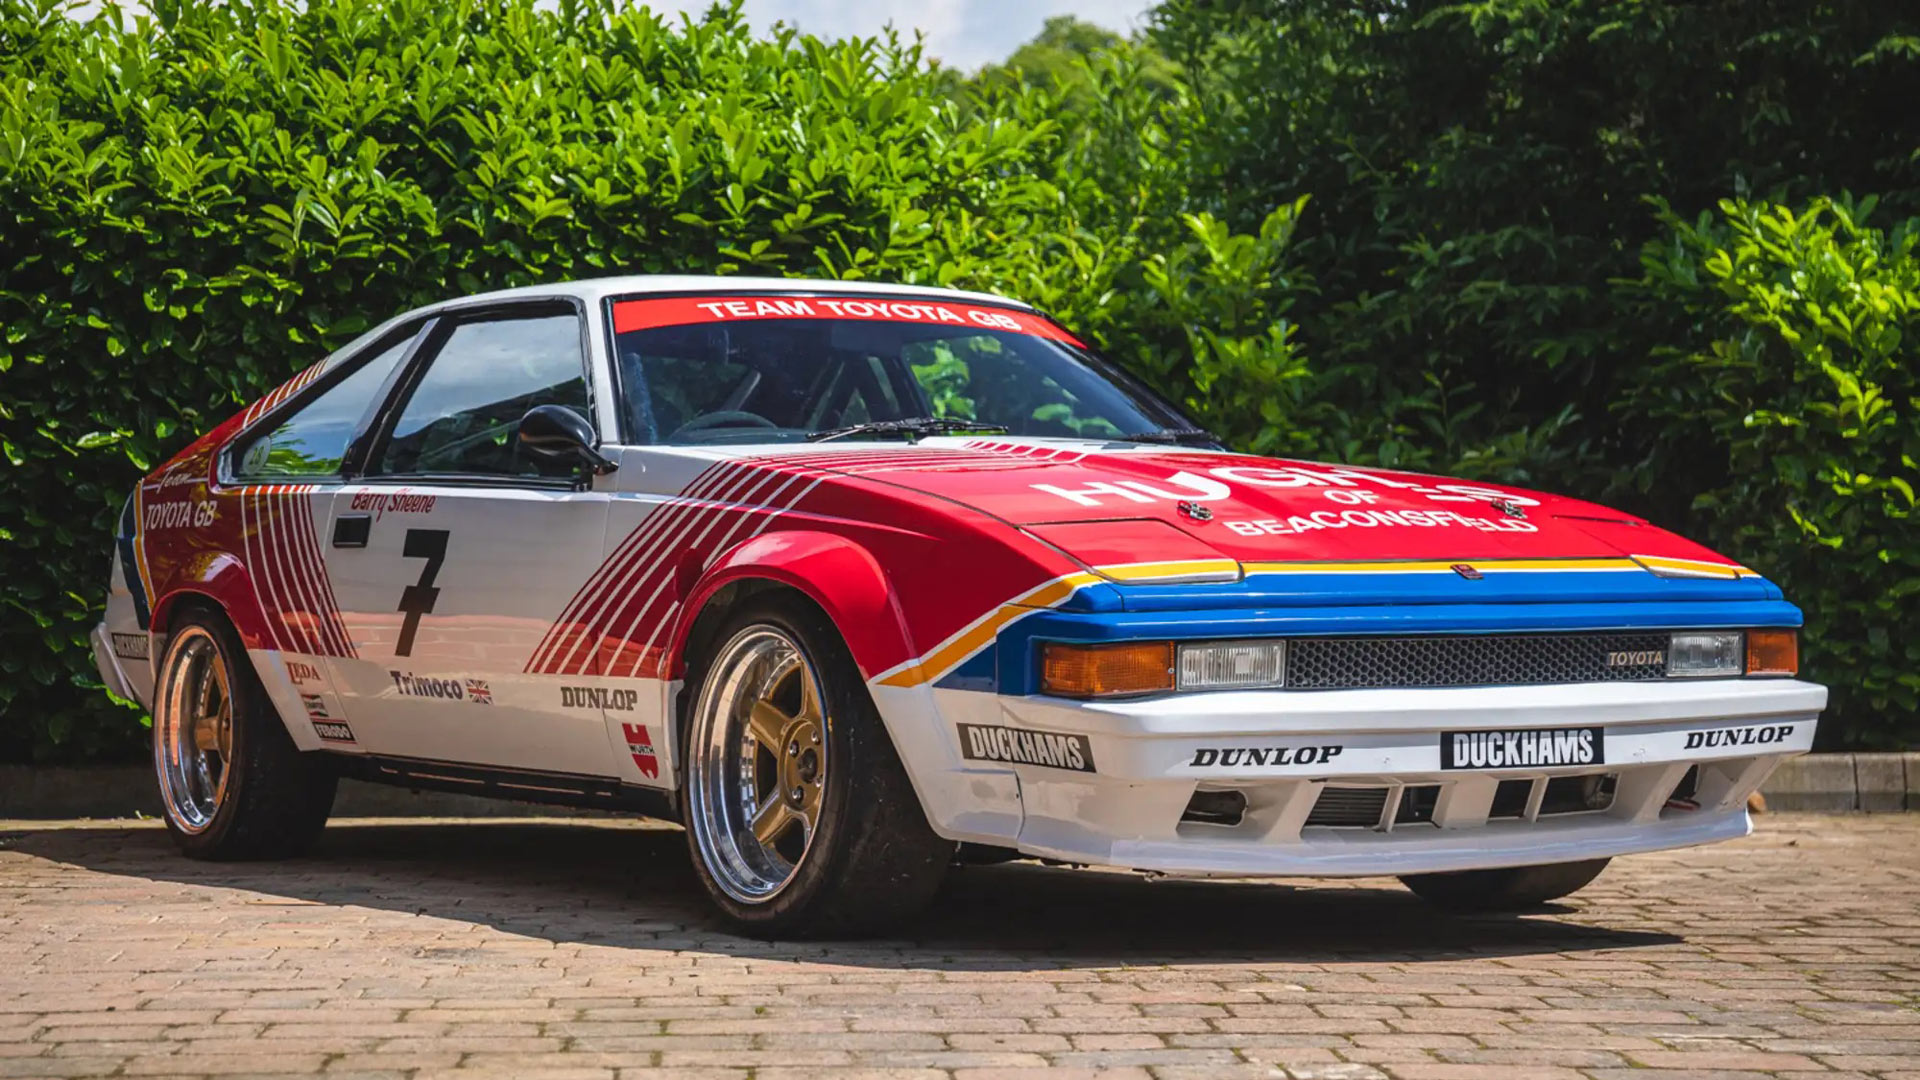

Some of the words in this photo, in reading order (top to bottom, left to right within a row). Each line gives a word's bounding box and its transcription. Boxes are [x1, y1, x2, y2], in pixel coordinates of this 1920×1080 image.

[697, 300, 815, 319] TEAM
[817, 300, 965, 323] TOYOTA
[968, 310, 1022, 331] GB
[351, 487, 389, 523] Barry
[387, 487, 436, 514] Sheene
[1323, 489, 1380, 505] OF
[145, 501, 192, 530] TOYOTA
[194, 500, 218, 528] GB
[394, 529, 450, 657] 7
[286, 661, 321, 685] LEDA
[1608, 650, 1664, 666] TOYOTA
[390, 670, 464, 700] Trimoco
[561, 686, 638, 711] DUNLOP
[967, 725, 1085, 770] DUCKHAMS
[1453, 729, 1594, 768] DUCKHAMS
[1684, 726, 1794, 750] DUNLOP
[1189, 745, 1343, 767] DUNLOP
